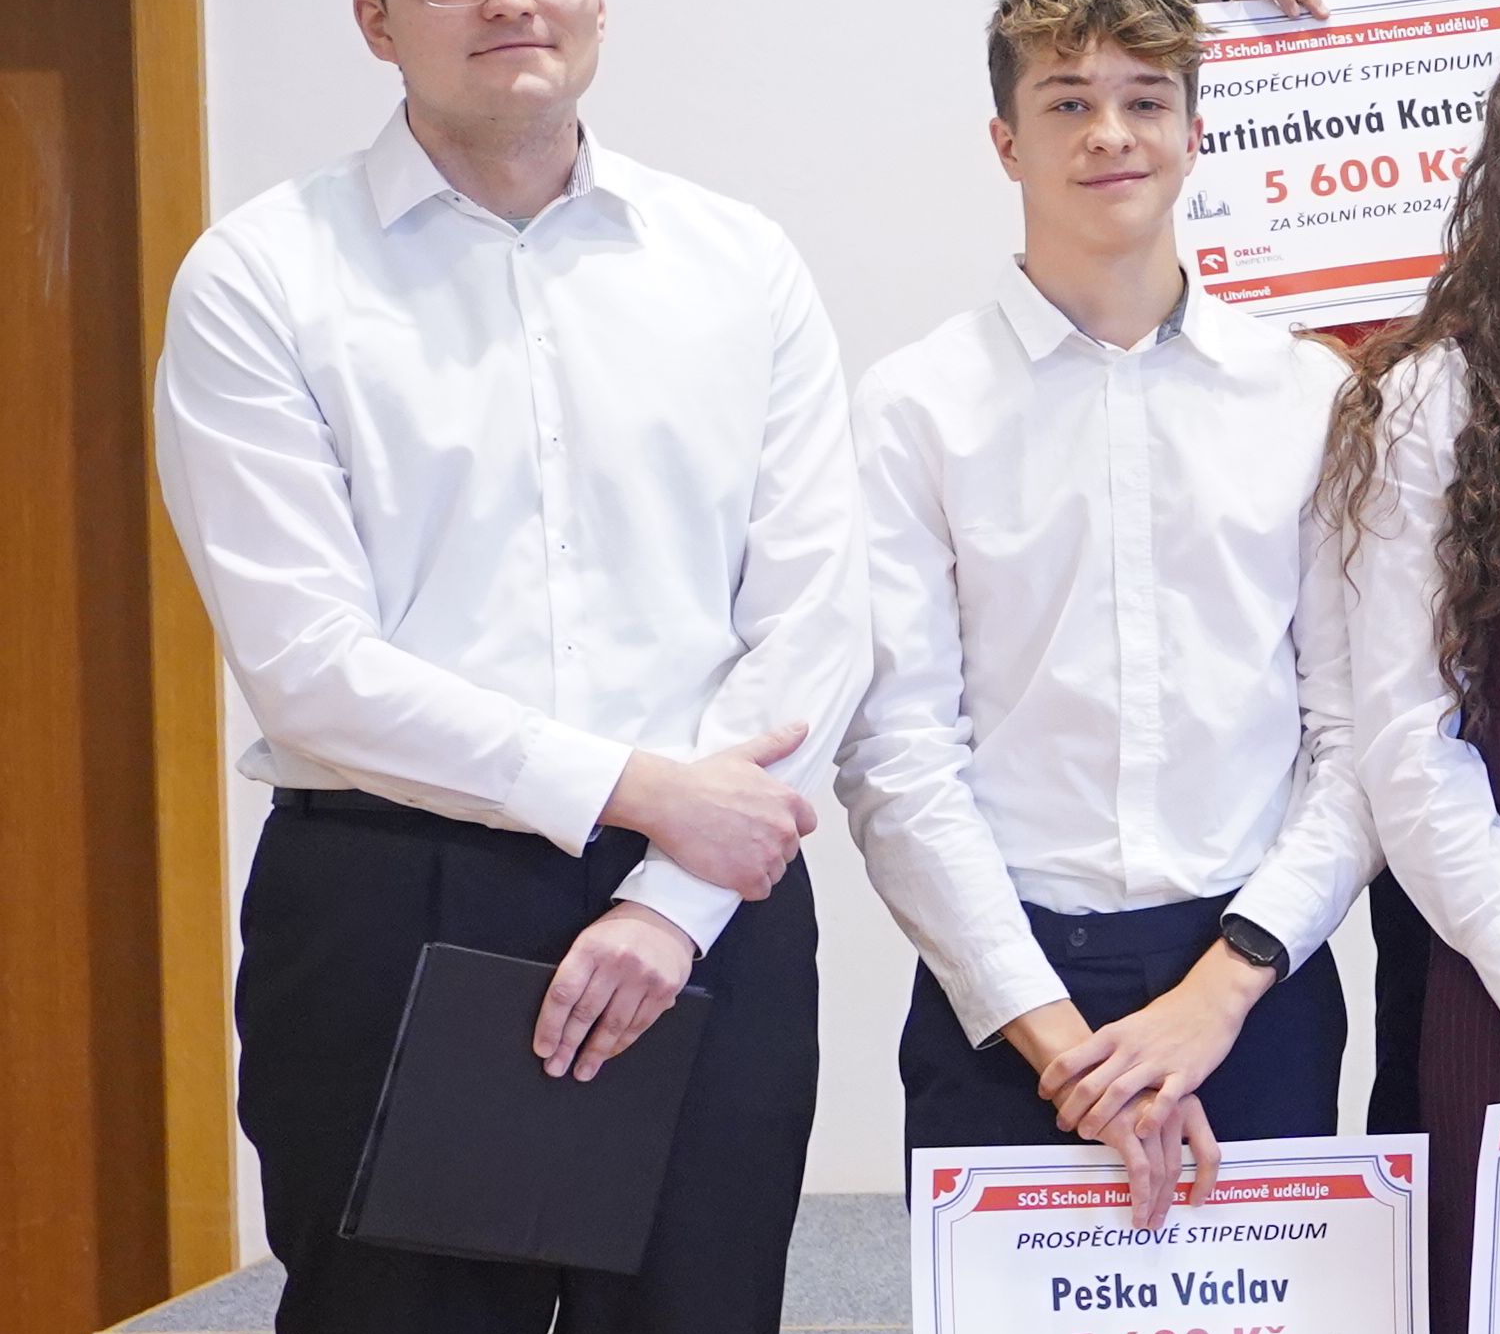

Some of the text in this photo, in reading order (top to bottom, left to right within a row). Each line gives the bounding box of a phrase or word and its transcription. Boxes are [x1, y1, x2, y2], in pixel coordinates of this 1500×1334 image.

[1226, 16, 1489, 59] Schola Humanitas Litvínově uděluje
[1200, 52, 1493, 99] PROSPĚCHOVÉ STIPENDIUM
[1200, 104, 1384, 155] artináková
[1265, 154, 1399, 204] 5 600
[1297, 204, 1397, 228] ŠKOLNÍ ROK
[1016, 1223, 1328, 1249] PROSPĚCHOVÉ STIPENDIUM
[1052, 1267, 1289, 1312] Peška Václav
